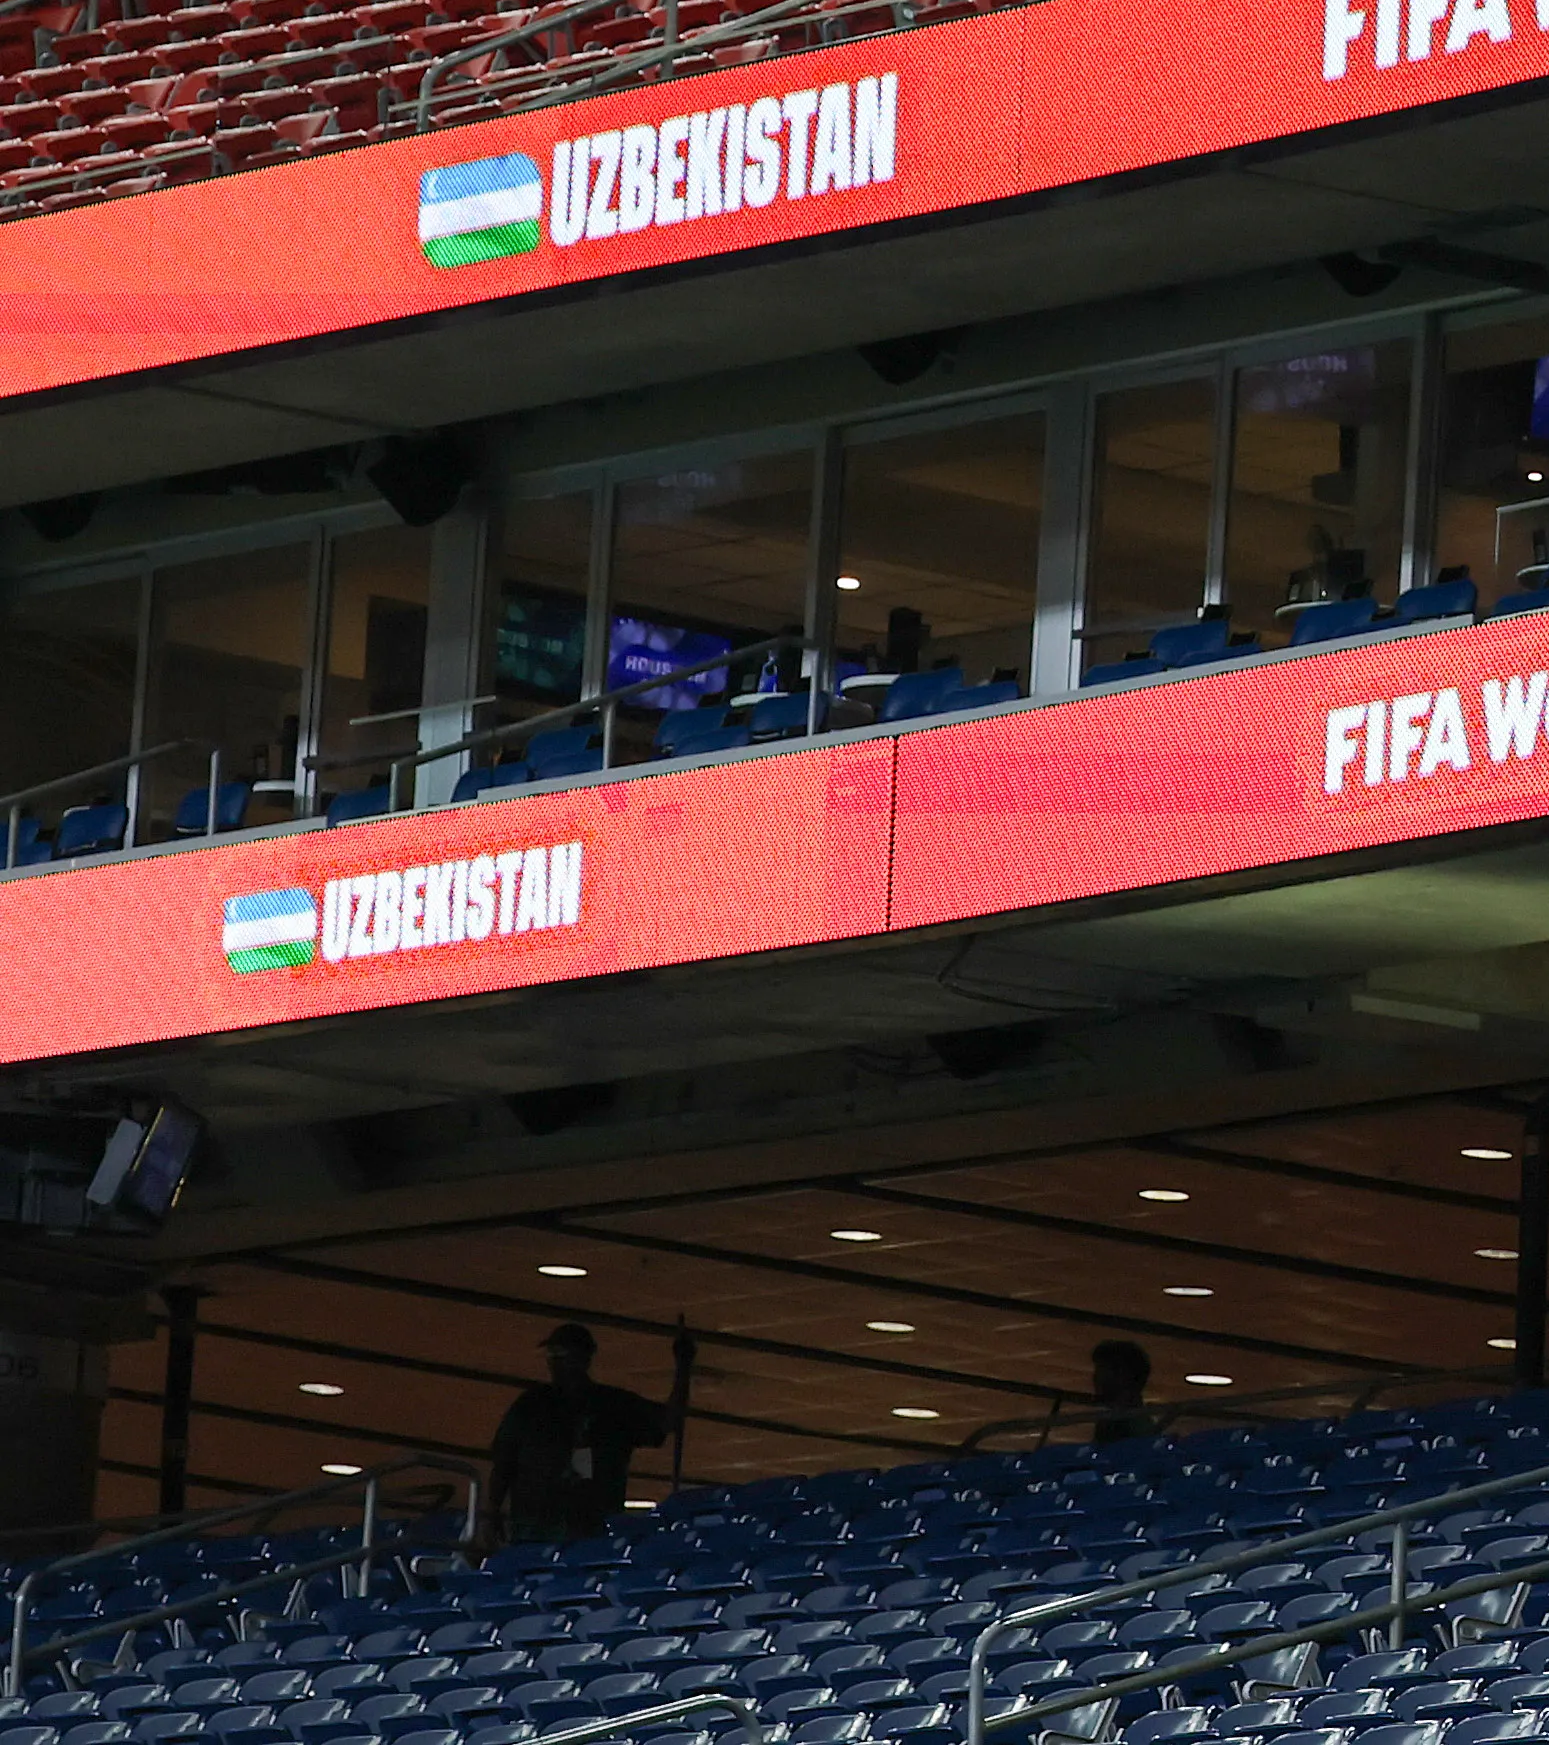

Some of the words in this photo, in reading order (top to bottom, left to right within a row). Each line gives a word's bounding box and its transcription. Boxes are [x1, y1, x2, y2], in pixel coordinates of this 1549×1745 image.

[549, 71, 899, 247] UZBEKISTAN
[1323, 686, 1471, 794] FIFA
[320, 839, 584, 966] UZBEKISTAN
